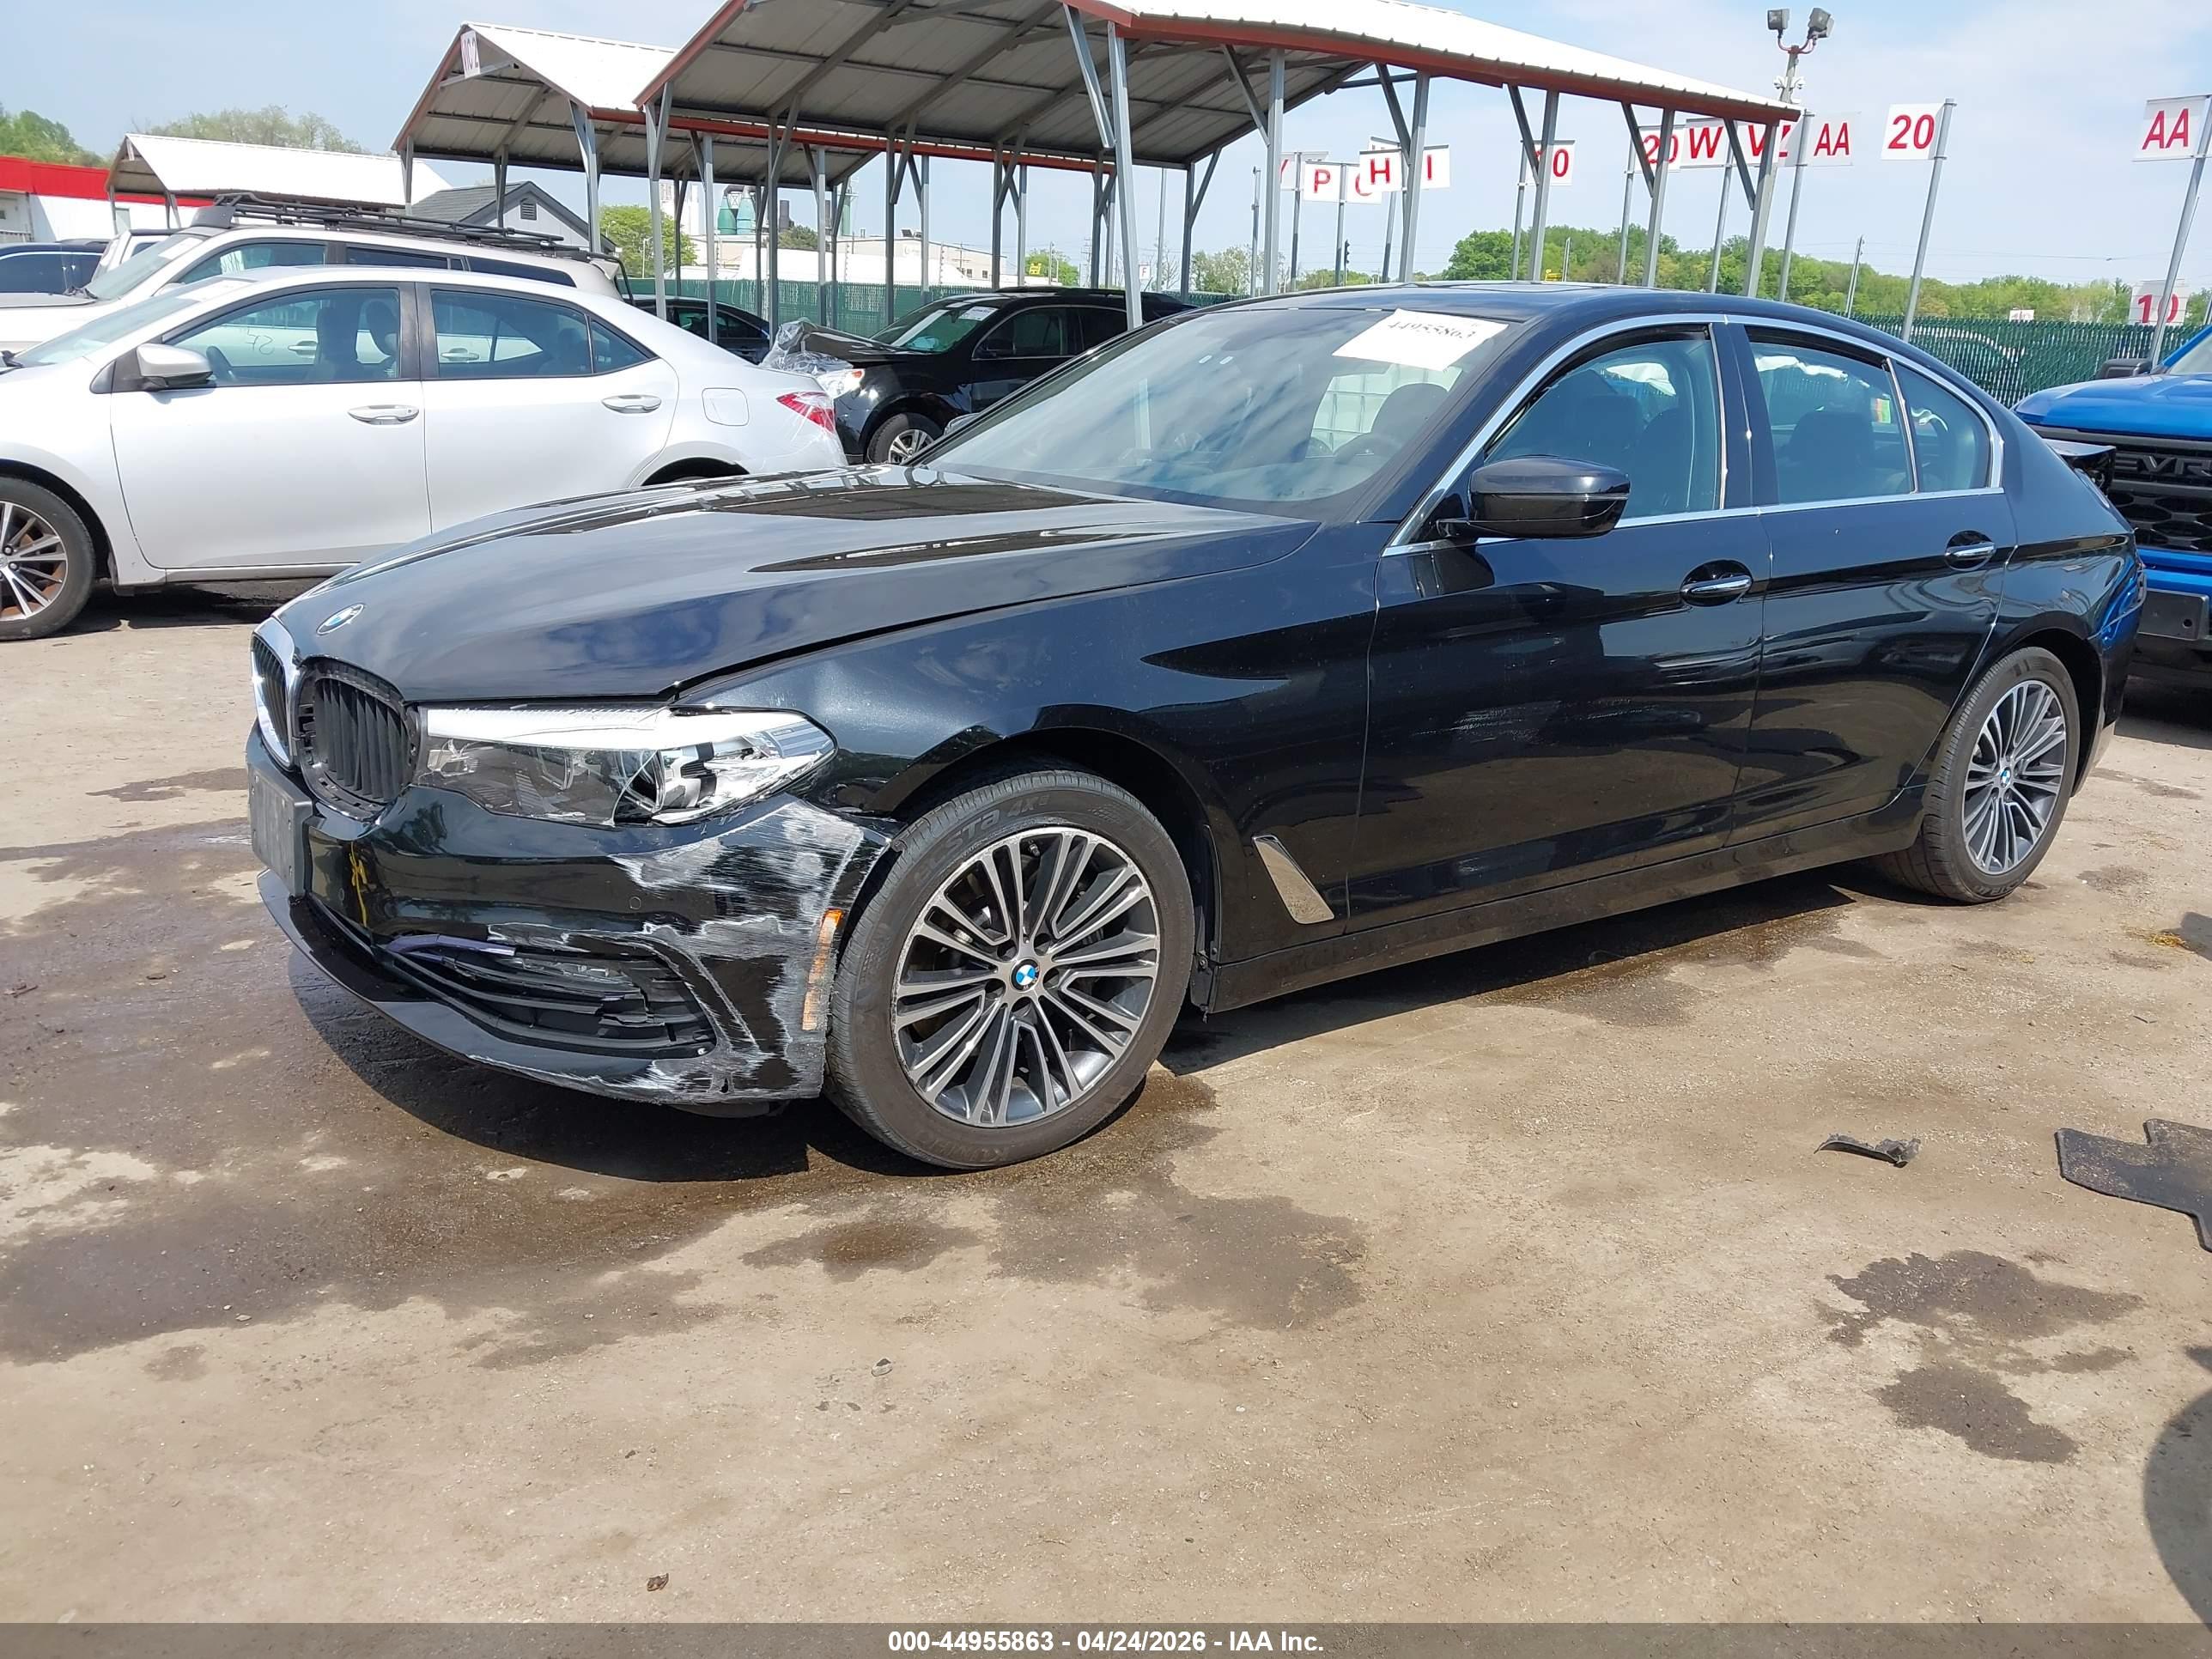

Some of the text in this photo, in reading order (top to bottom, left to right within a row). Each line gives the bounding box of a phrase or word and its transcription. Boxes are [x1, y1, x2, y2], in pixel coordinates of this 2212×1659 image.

[1689, 126, 1723, 159] W
[1814, 123, 1850, 156] AA
[1887, 113, 1935, 149] 20
[2142, 107, 2189, 149] AA
[1644, 134, 1679, 165] 20
[1314, 168, 1331, 193] P
[1370, 158, 1390, 185] H
[2138, 294, 2179, 324] 10
